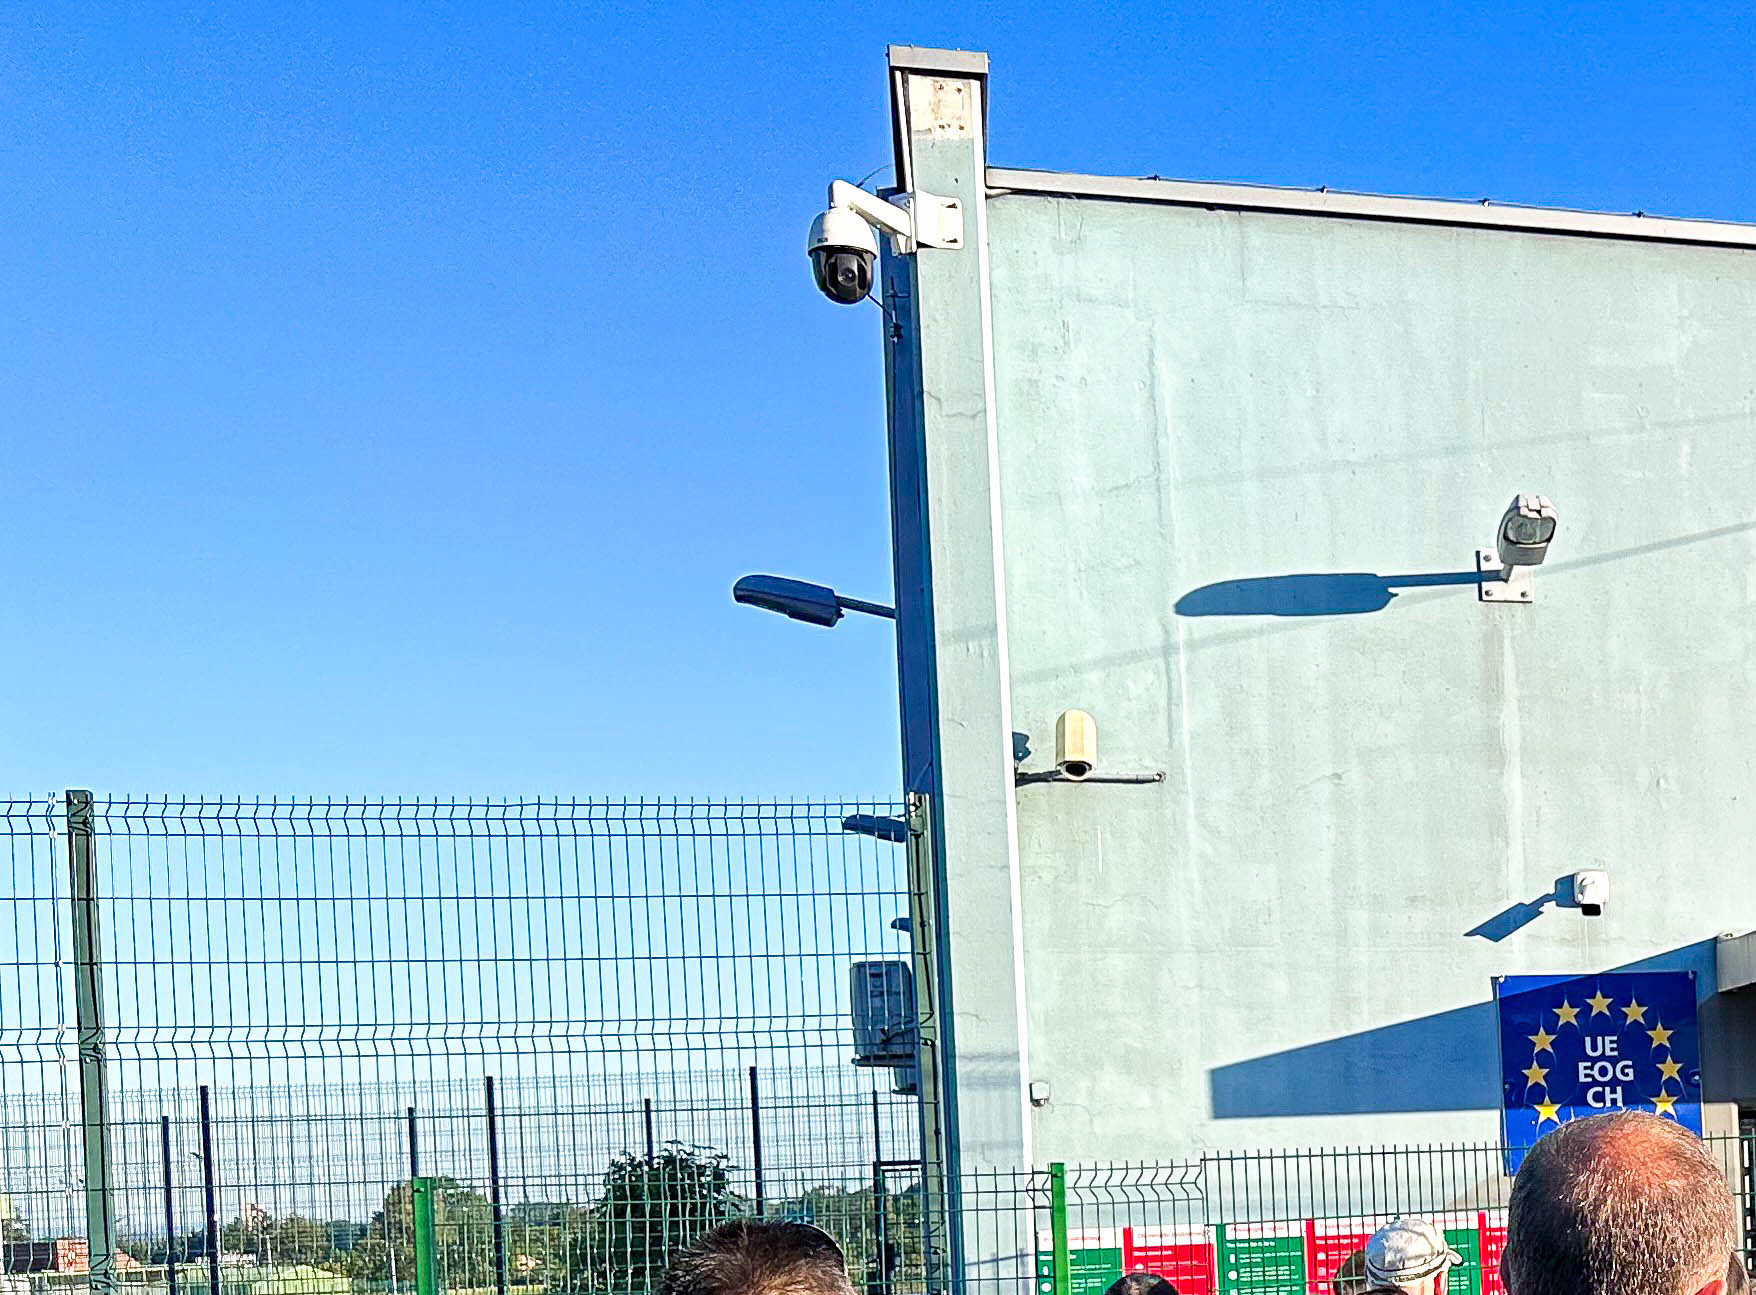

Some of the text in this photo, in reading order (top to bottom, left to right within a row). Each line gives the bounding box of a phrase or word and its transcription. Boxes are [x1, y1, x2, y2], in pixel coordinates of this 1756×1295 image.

[1584, 1035, 1619, 1057] UE
[1578, 1060, 1635, 1083] EOG
[1586, 1086, 1624, 1108] CH
